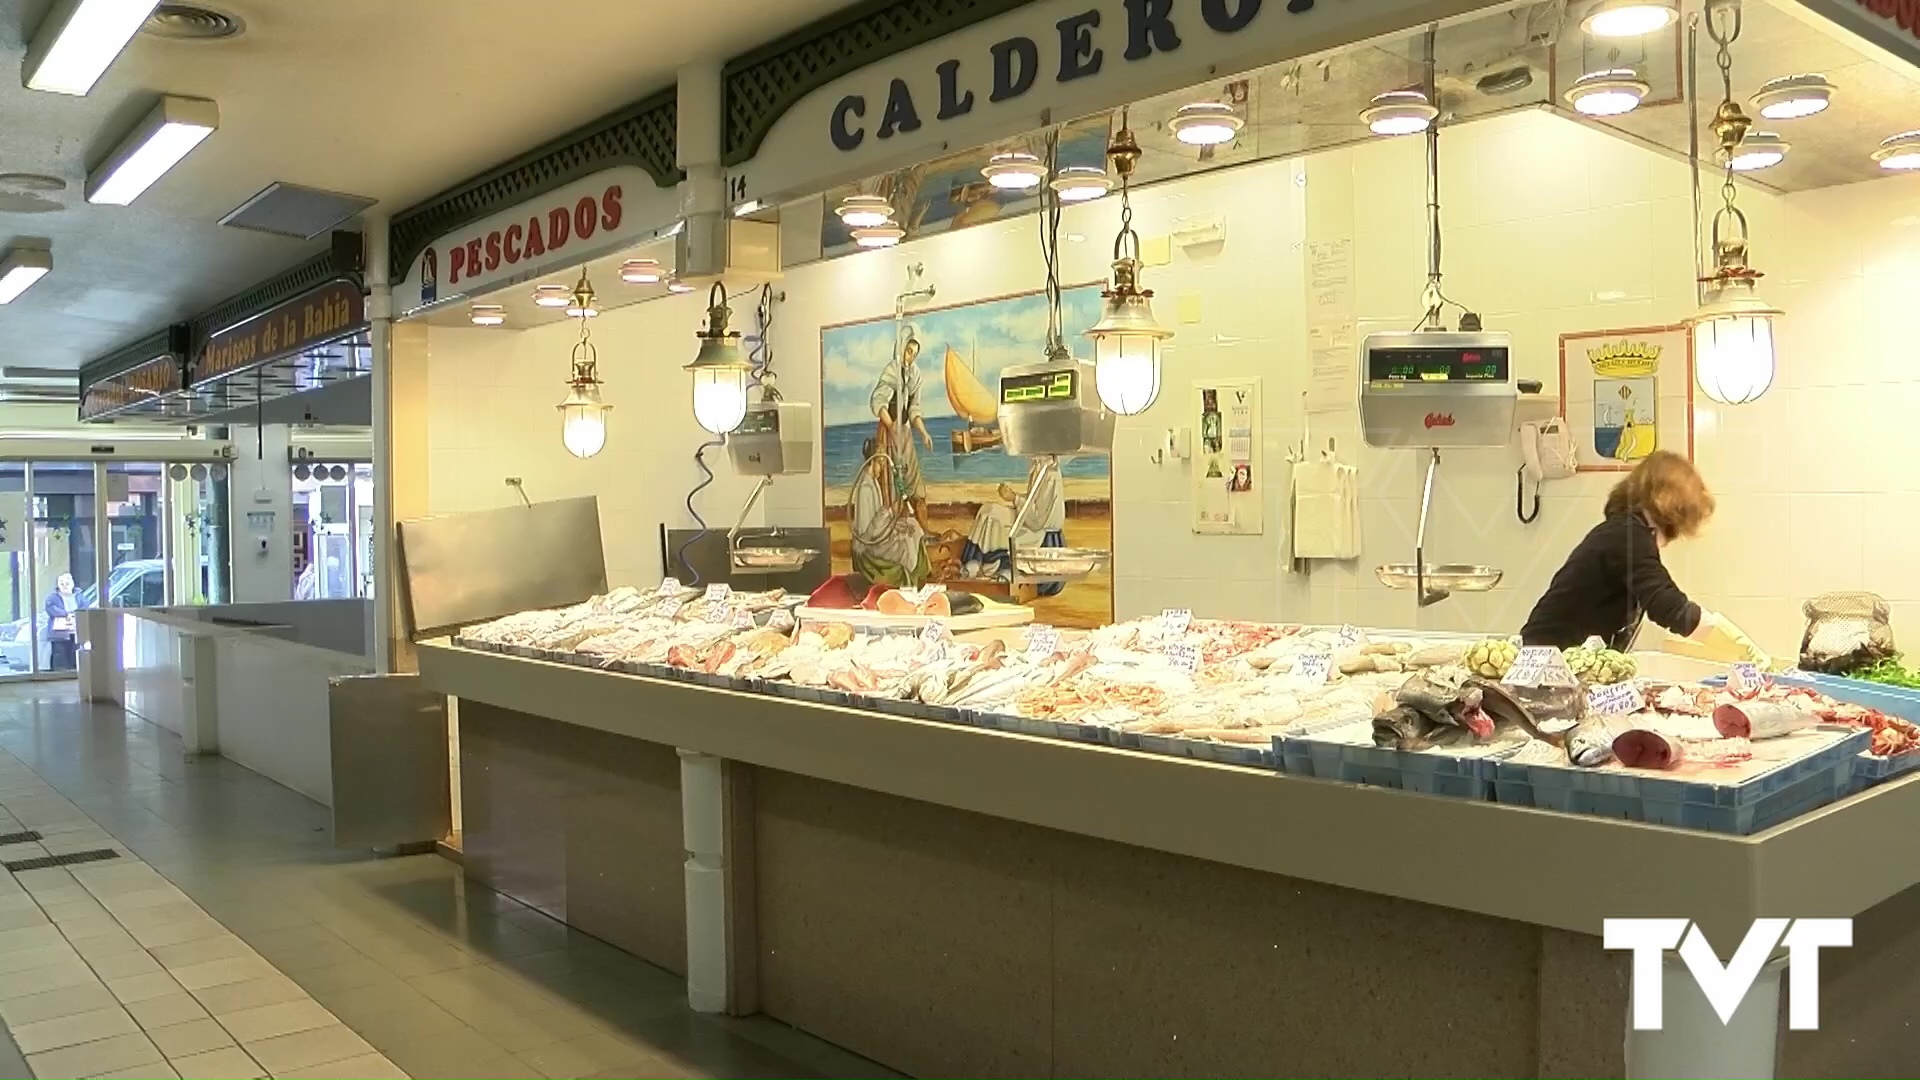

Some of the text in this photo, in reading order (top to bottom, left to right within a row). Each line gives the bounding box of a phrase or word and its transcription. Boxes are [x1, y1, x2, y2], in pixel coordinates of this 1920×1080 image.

[829, 0, 1315, 151] CALDERO
[731, 175, 746, 201] 14
[449, 184, 623, 284] PESCADOS
[206, 334, 257, 374] Mariscos
[262, 320, 279, 353] de
[283, 313, 297, 347] la
